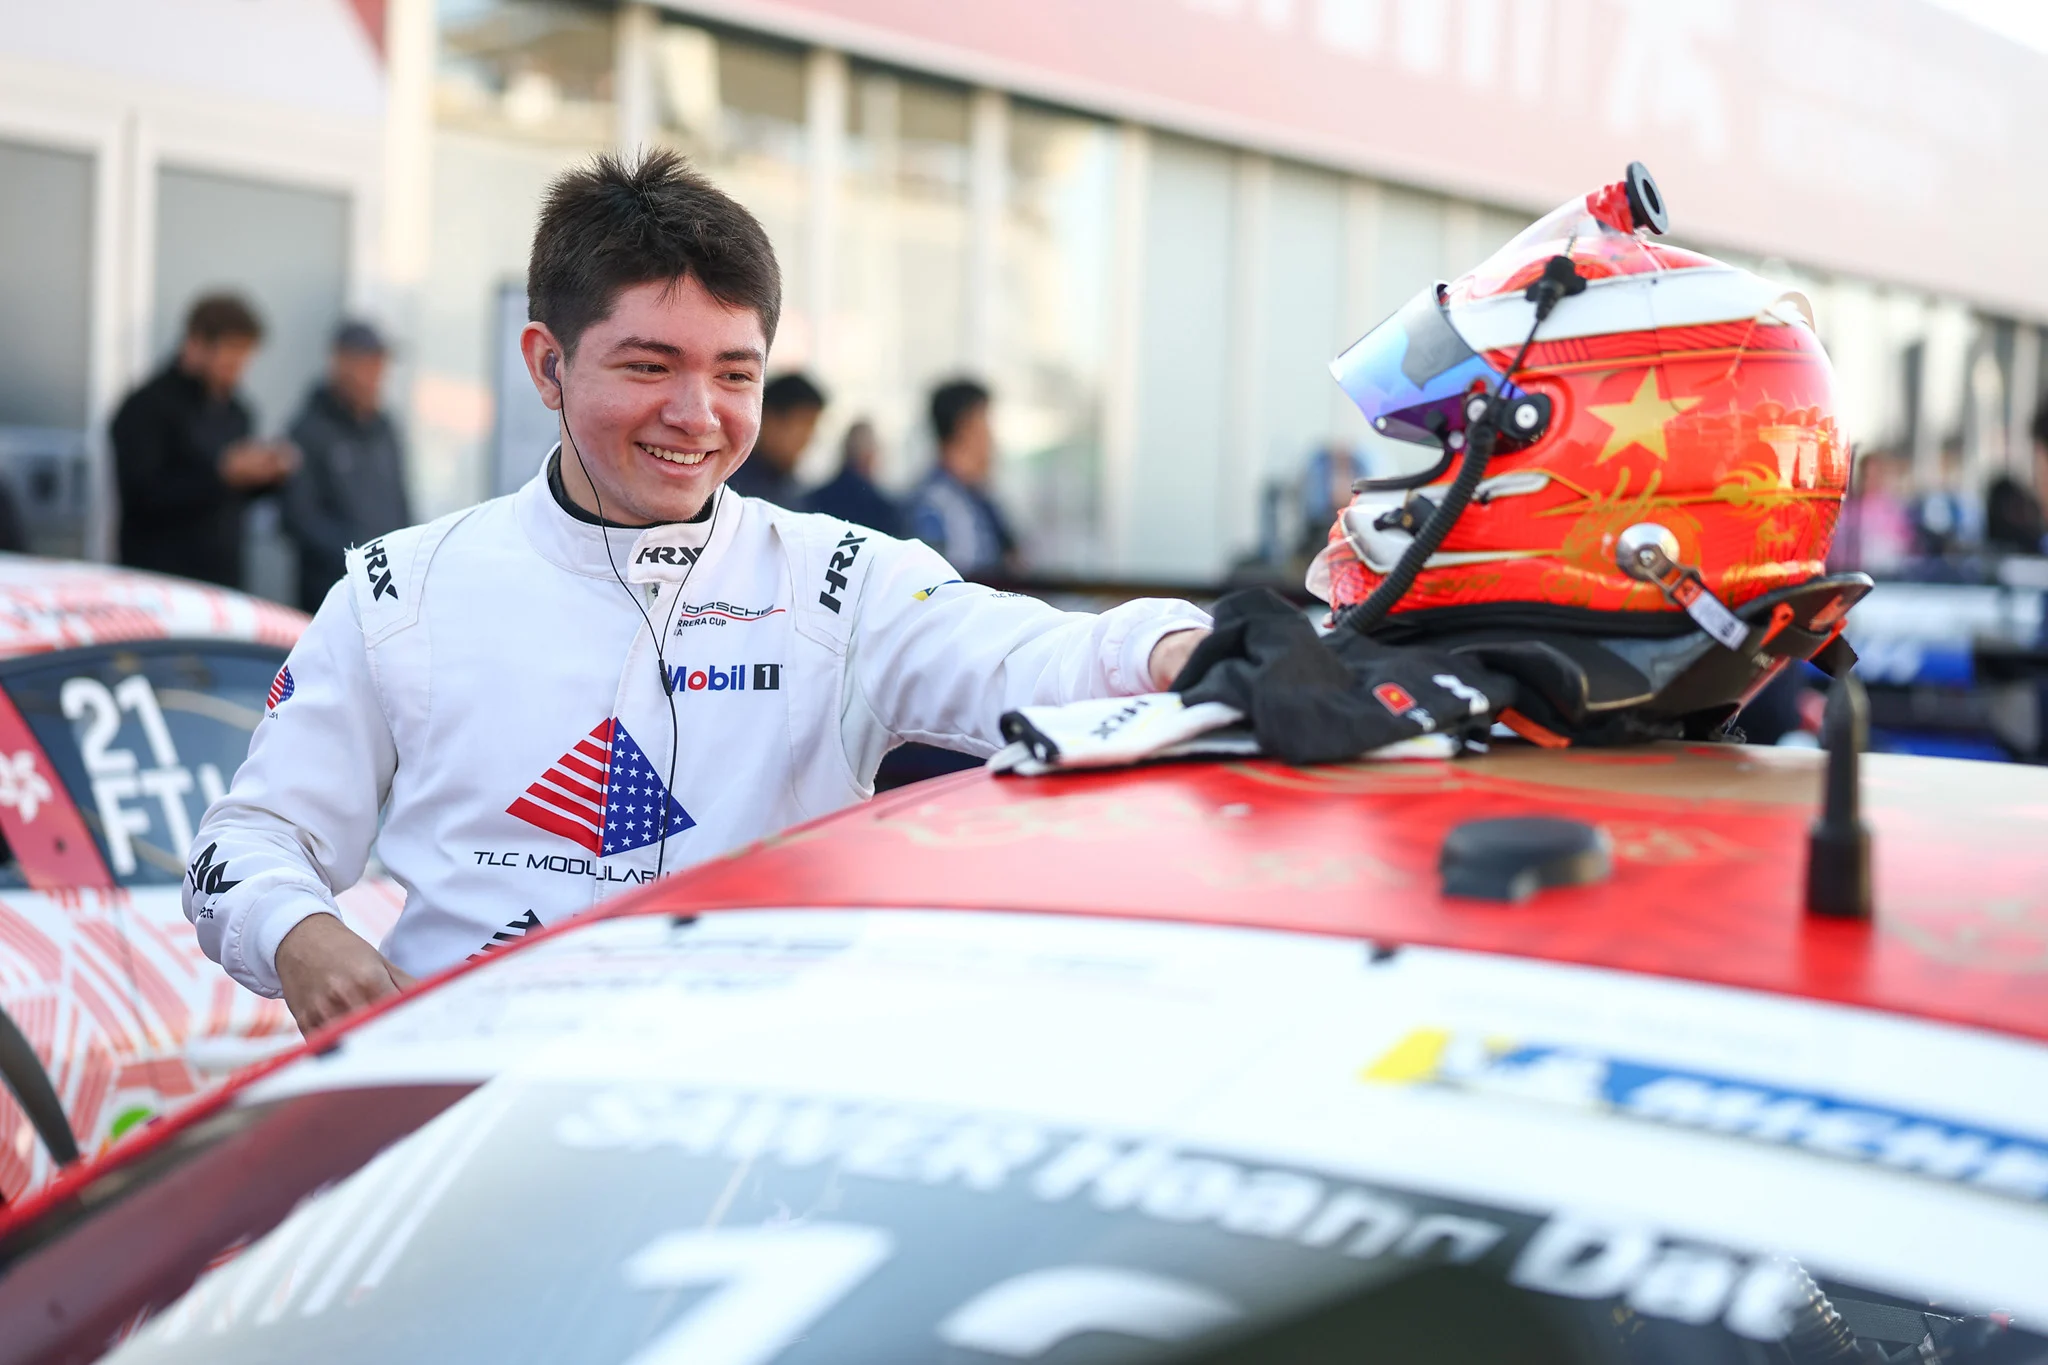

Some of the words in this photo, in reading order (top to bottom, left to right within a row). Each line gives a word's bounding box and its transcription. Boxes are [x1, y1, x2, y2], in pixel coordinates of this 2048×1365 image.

[364, 539, 398, 601] HRX
[635, 547, 704, 566] HRX
[819, 531, 868, 614] HRX
[682, 601, 774, 617] ORSCHE
[709, 617, 727, 627] CUP
[667, 664, 745, 692] Mobil
[61, 675, 179, 774] 21
[474, 852, 519, 867] TLC
[526, 854, 657, 885] MODULAR
